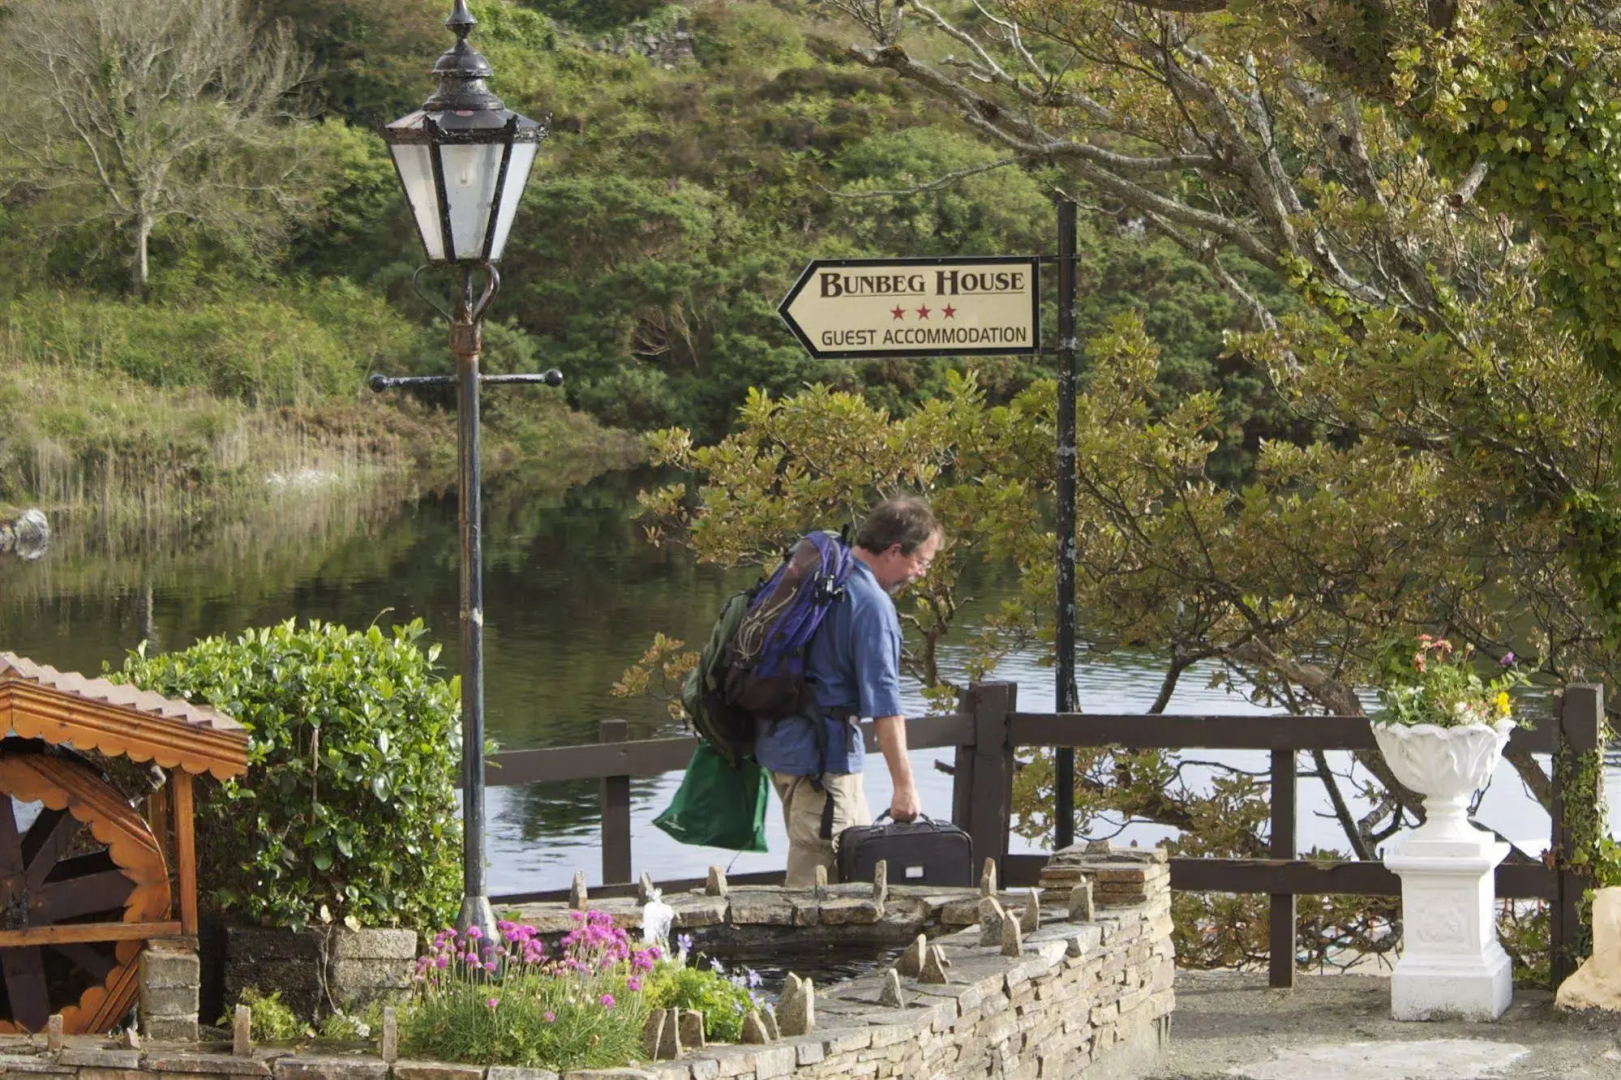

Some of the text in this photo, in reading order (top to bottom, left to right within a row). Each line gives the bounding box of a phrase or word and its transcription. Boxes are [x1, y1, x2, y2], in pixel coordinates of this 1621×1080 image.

[820, 270, 1025, 298] BUNBEG HOUSE
[822, 327, 1026, 346] GUEST ACCOMMODATION
